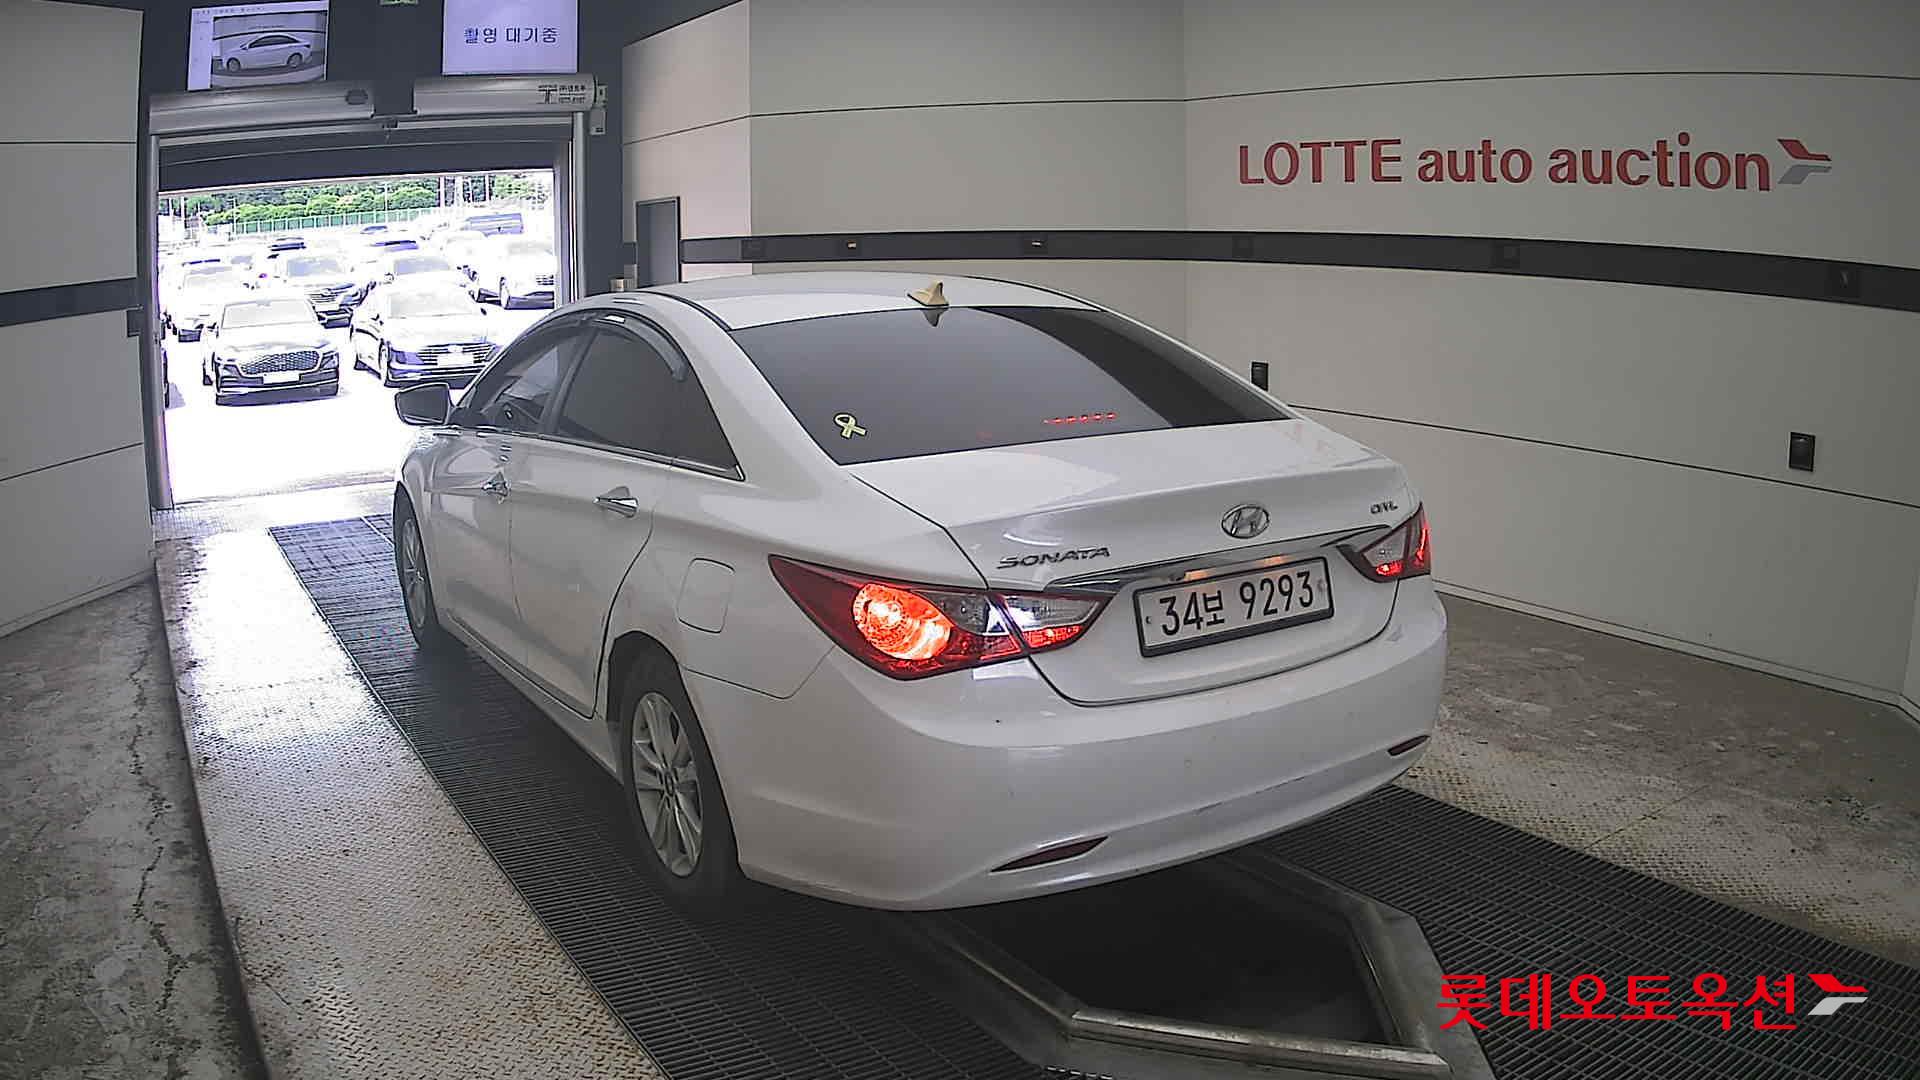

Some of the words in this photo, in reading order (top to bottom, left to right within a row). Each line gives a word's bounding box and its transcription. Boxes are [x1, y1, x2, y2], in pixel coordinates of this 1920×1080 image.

[505, 27, 557, 43] 대기중
[1239, 138, 1401, 185] LOTTE
[1418, 140, 1532, 184] auto
[1548, 132, 1771, 191] auction
[996, 547, 1110, 569] SONATA
[1160, 589, 1225, 636] 34보
[1239, 571, 1314, 620] 9293
